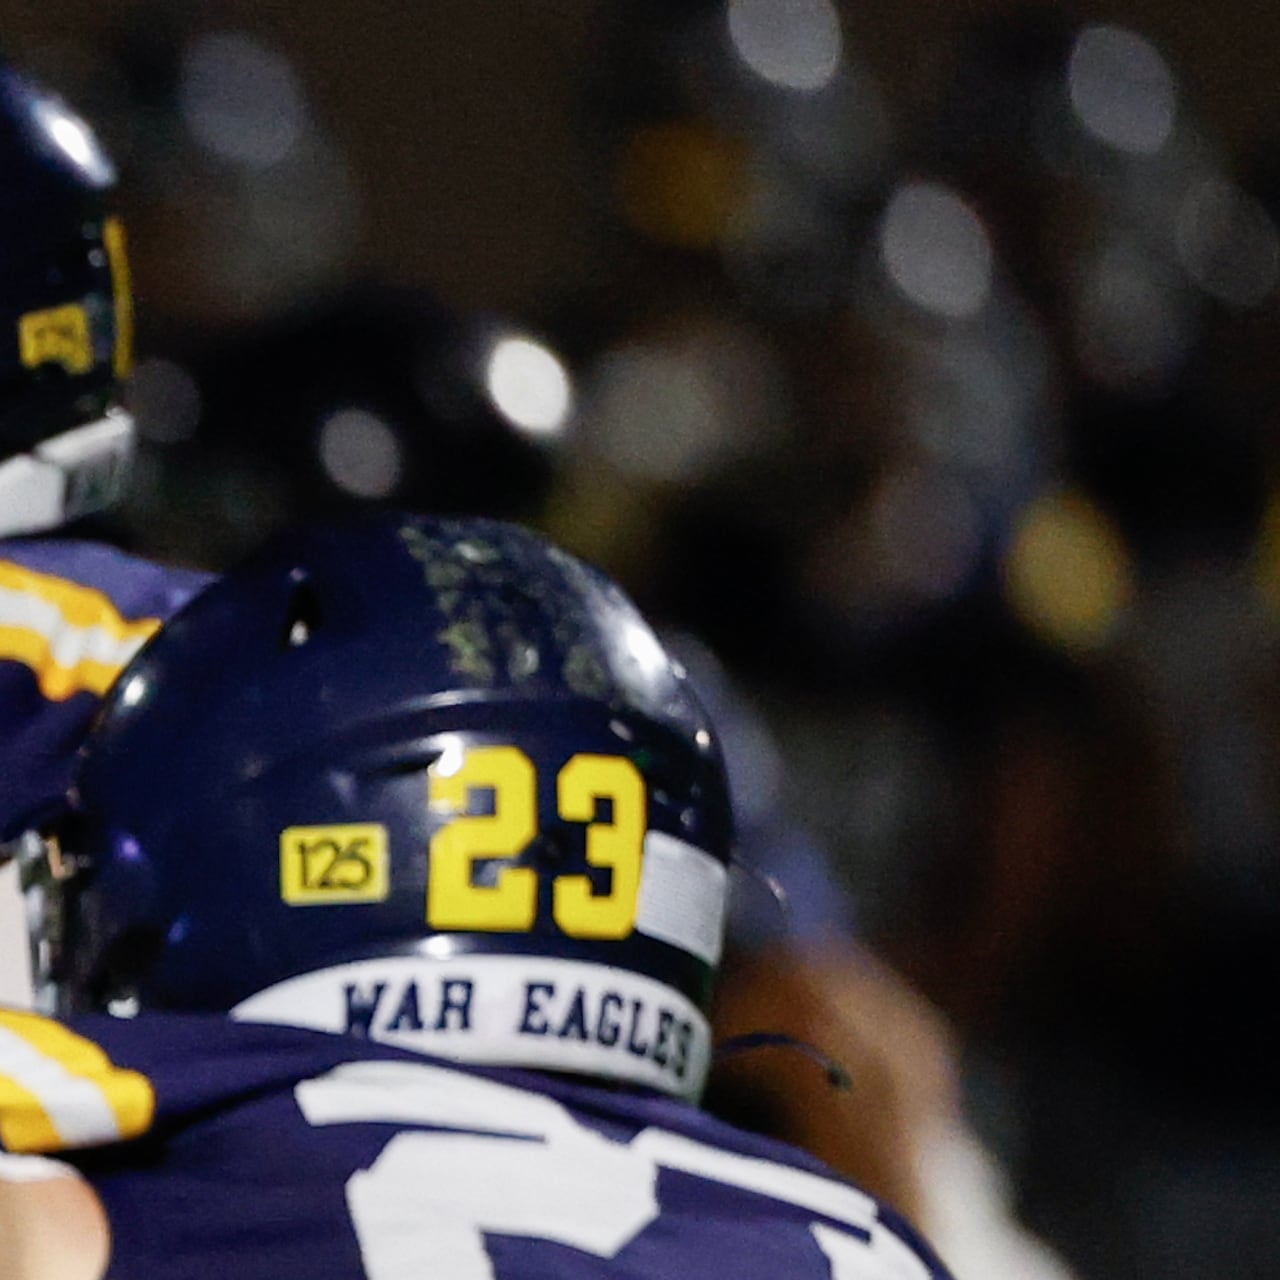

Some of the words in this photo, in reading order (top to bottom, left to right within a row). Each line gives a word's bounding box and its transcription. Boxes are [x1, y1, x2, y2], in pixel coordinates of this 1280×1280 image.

[296, 836, 374, 892] 125
[426, 744, 647, 941] 23
[342, 976, 476, 1042] WAR
[517, 980, 696, 1082] EAGLES
